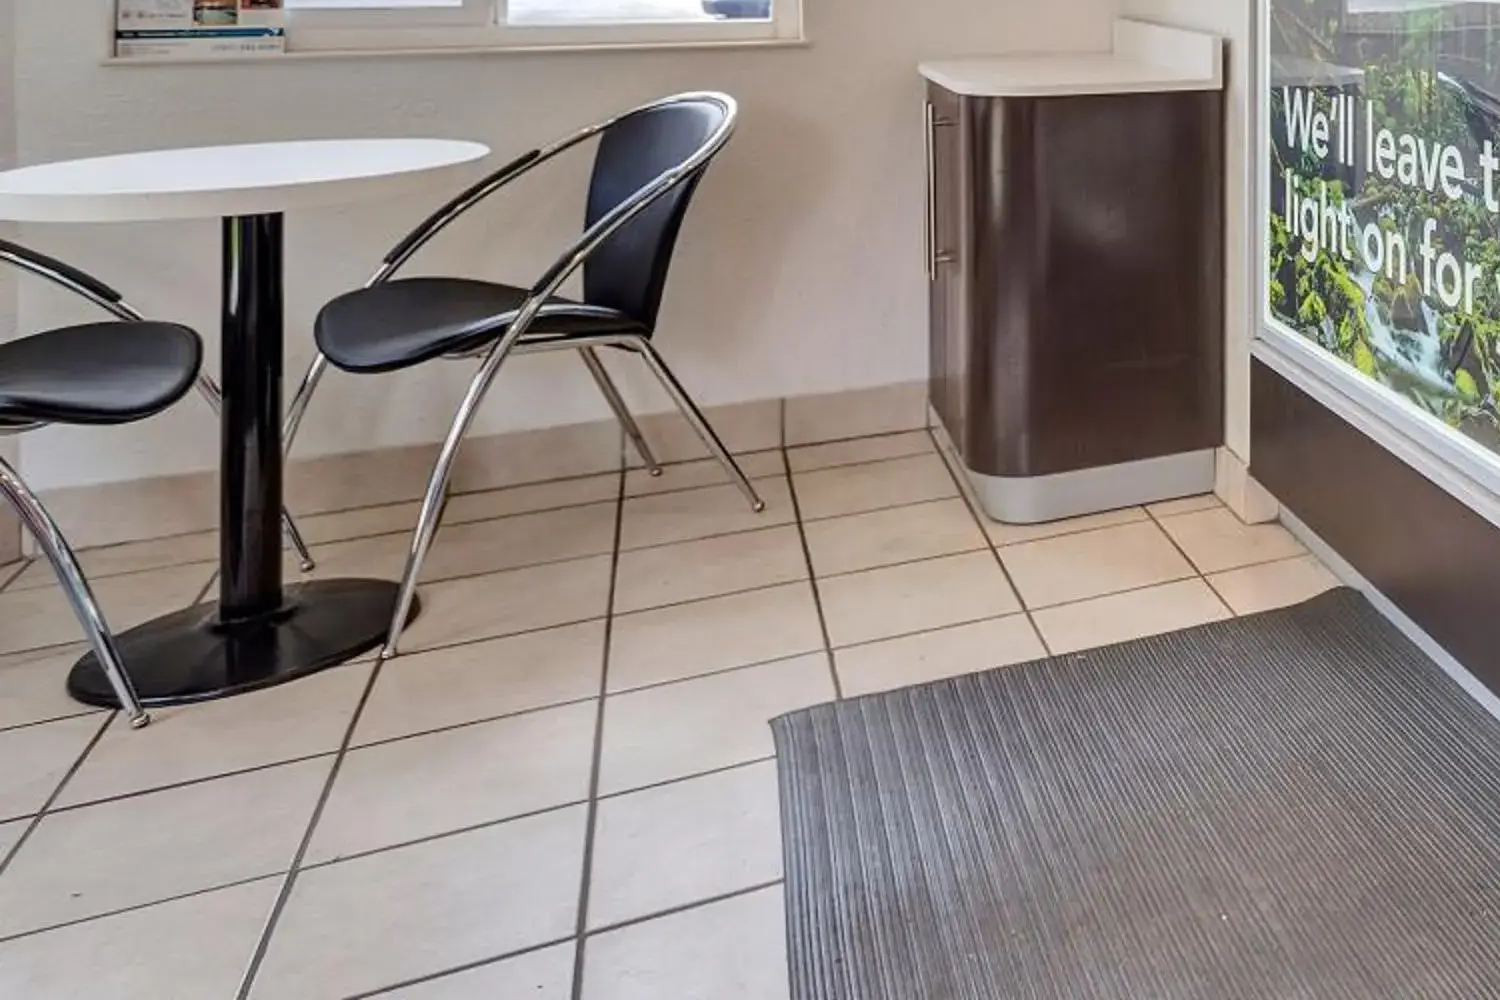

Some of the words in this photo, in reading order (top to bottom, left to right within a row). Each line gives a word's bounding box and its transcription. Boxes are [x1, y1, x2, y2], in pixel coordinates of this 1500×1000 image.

[1282, 85, 1354, 167] We'll
[1366, 99, 1466, 201] leave
[1284, 168, 1353, 264] light
[1361, 221, 1408, 285] on
[1419, 218, 1482, 314] for
